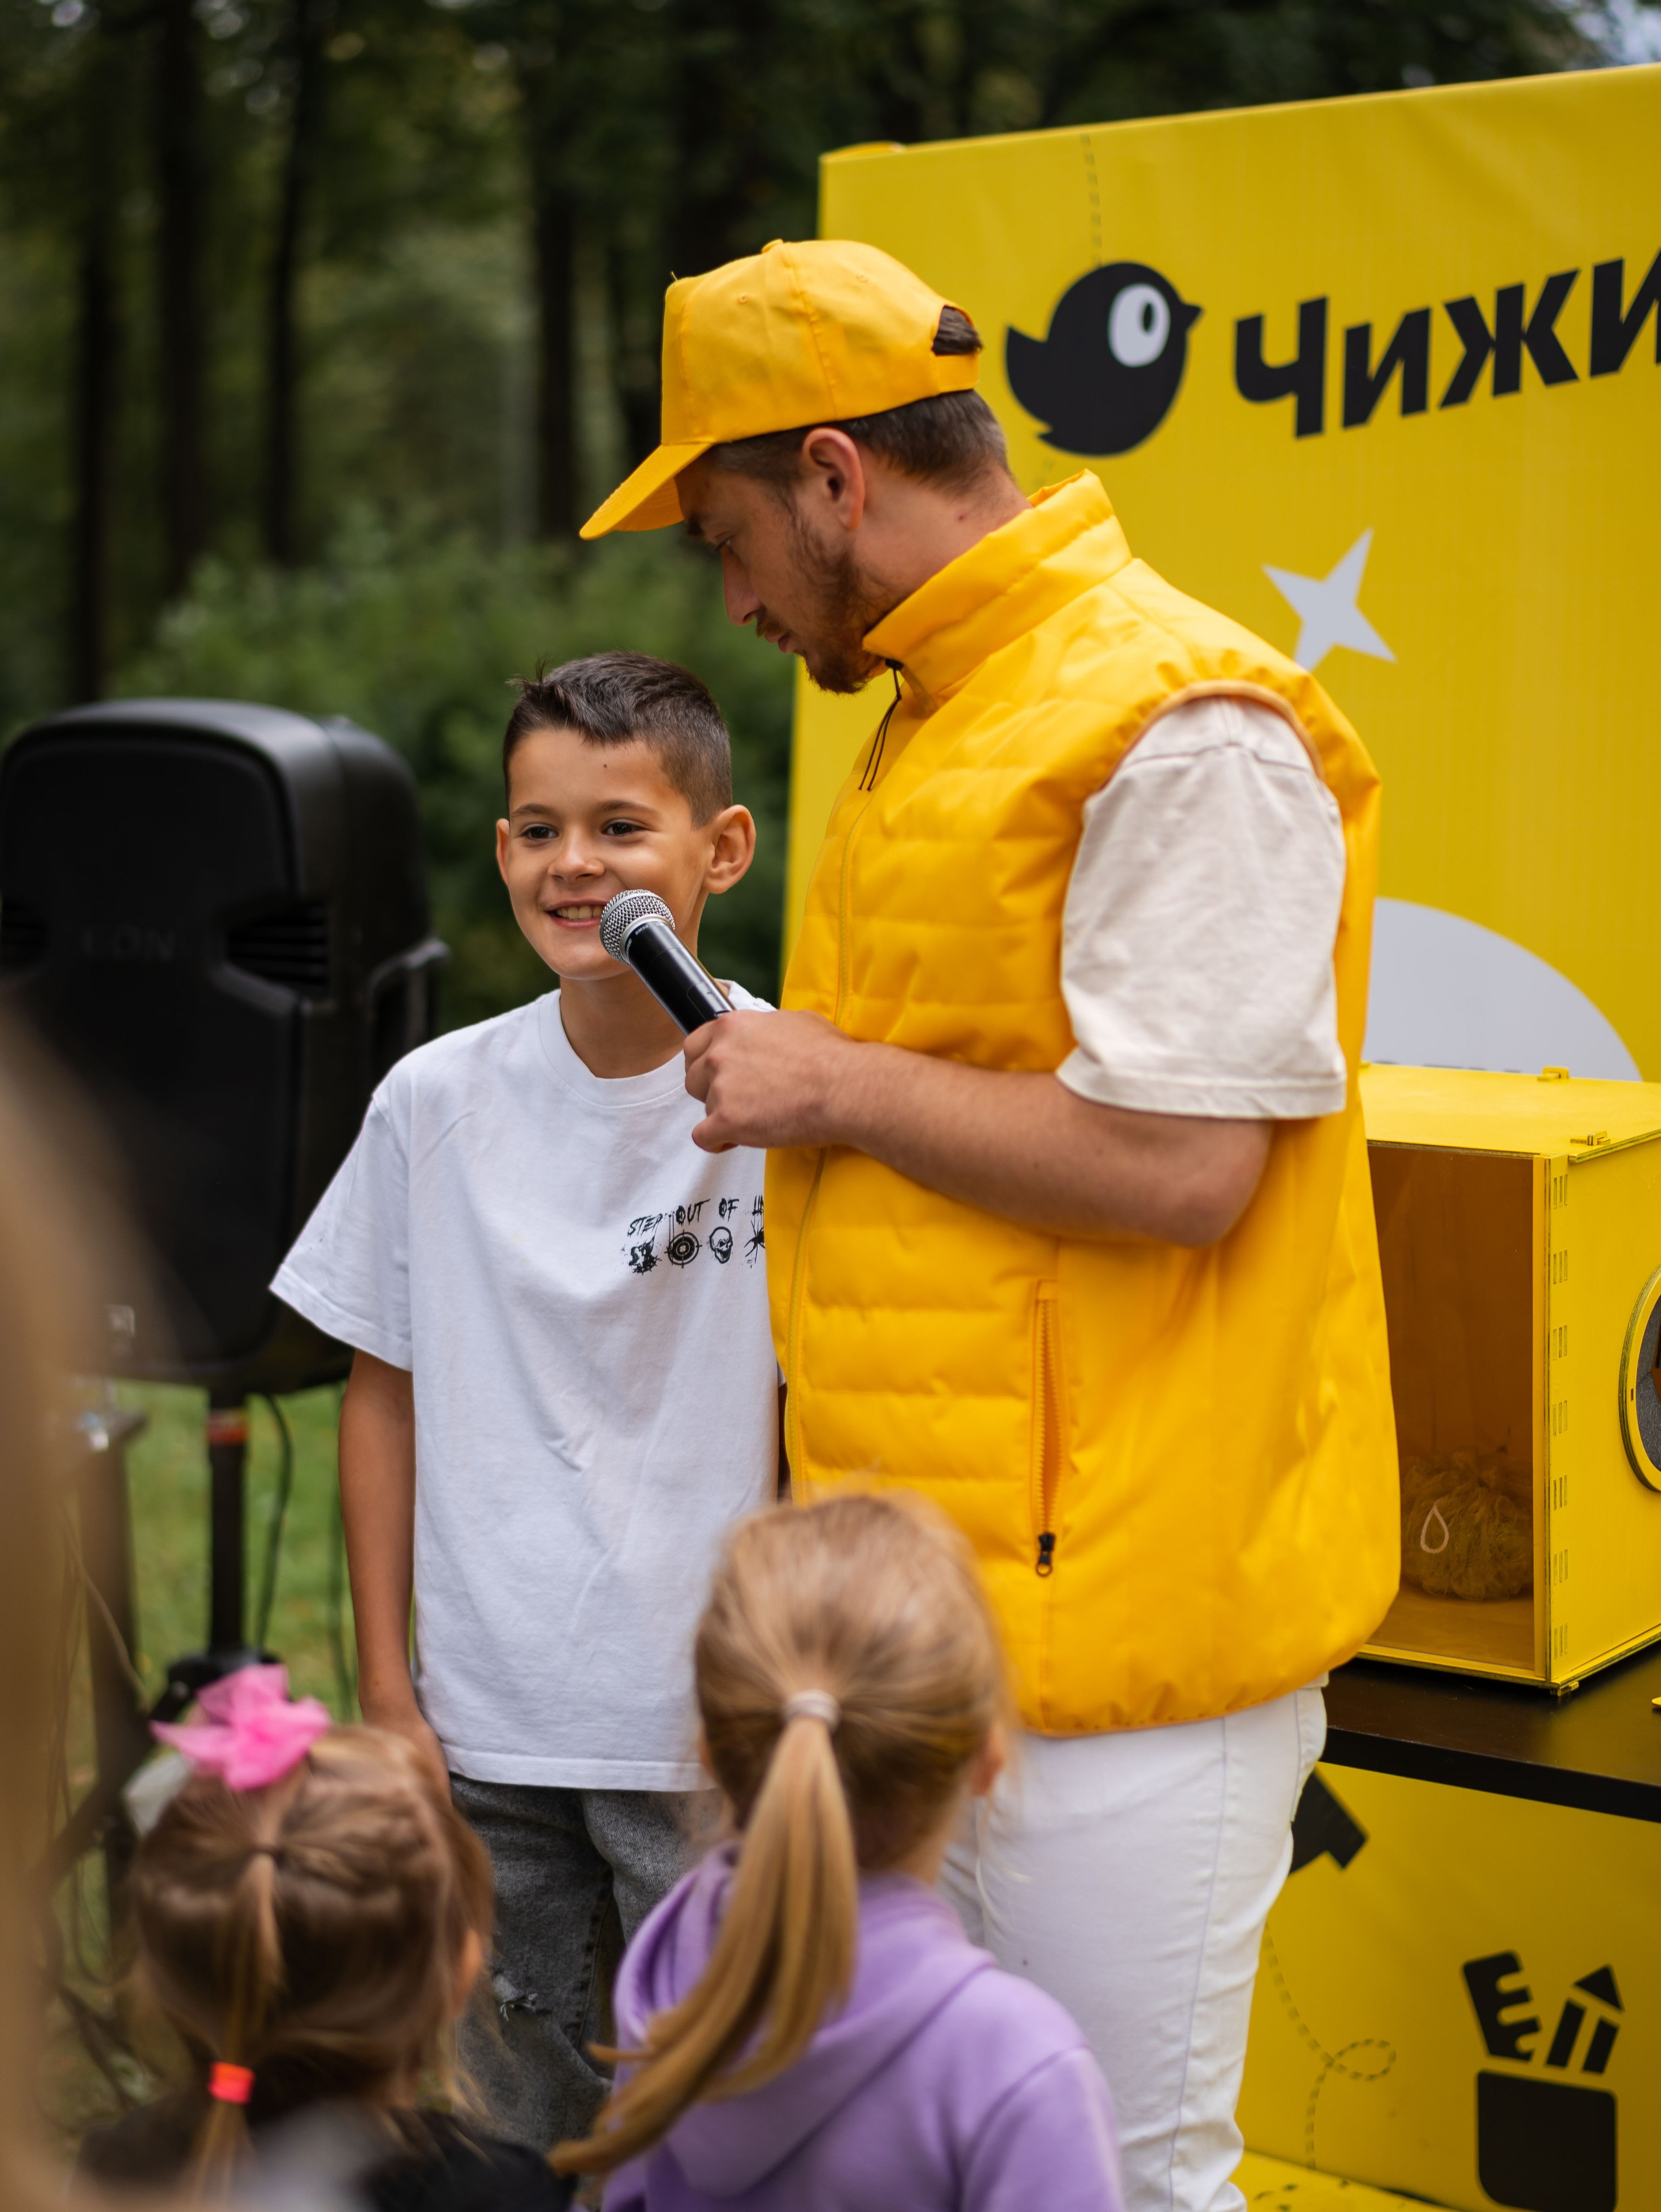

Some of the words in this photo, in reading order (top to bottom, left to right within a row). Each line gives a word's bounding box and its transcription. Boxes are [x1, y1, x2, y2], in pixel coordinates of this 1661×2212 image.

[627, 1213, 663, 1236] STEP
[675, 1199, 710, 1225] OUT
[718, 1198, 740, 1221] OF
